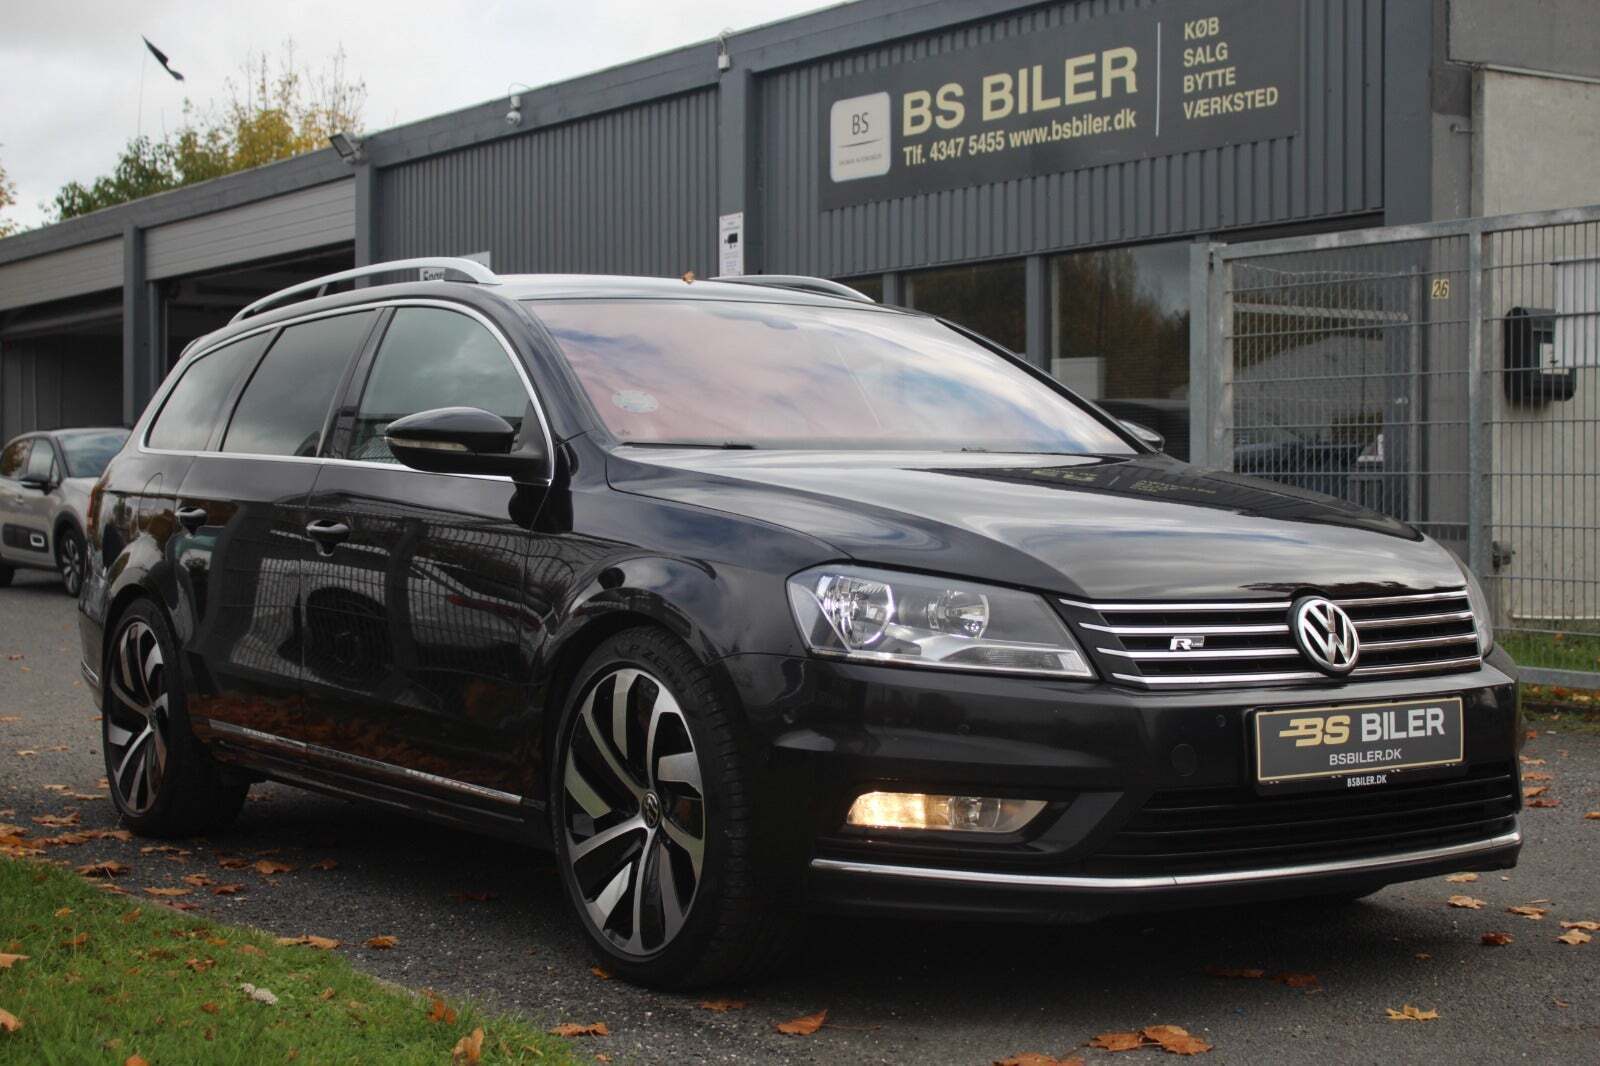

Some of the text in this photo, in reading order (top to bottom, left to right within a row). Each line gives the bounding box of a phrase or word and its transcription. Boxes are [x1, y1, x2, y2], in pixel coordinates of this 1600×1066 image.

[1185, 17, 1218, 40] KØB
[1184, 42, 1228, 67] SALG
[903, 47, 1138, 136] BS BILER
[1184, 66, 1236, 94] BYTTE
[1183, 87, 1278, 120] VÆRKSTED
[852, 112, 869, 135] BS
[903, 147, 926, 166] Tlf.
[930, 138, 964, 161] 4347
[968, 130, 1004, 156] 5455
[1009, 109, 1137, 149] www.bsbiler.dk
[1433, 280, 1448, 297] 26
[1280, 707, 1445, 747] BS BILER
[1329, 749, 1402, 766] BSBILER.DK
[1347, 774, 1387, 787] BSBILER.DK
